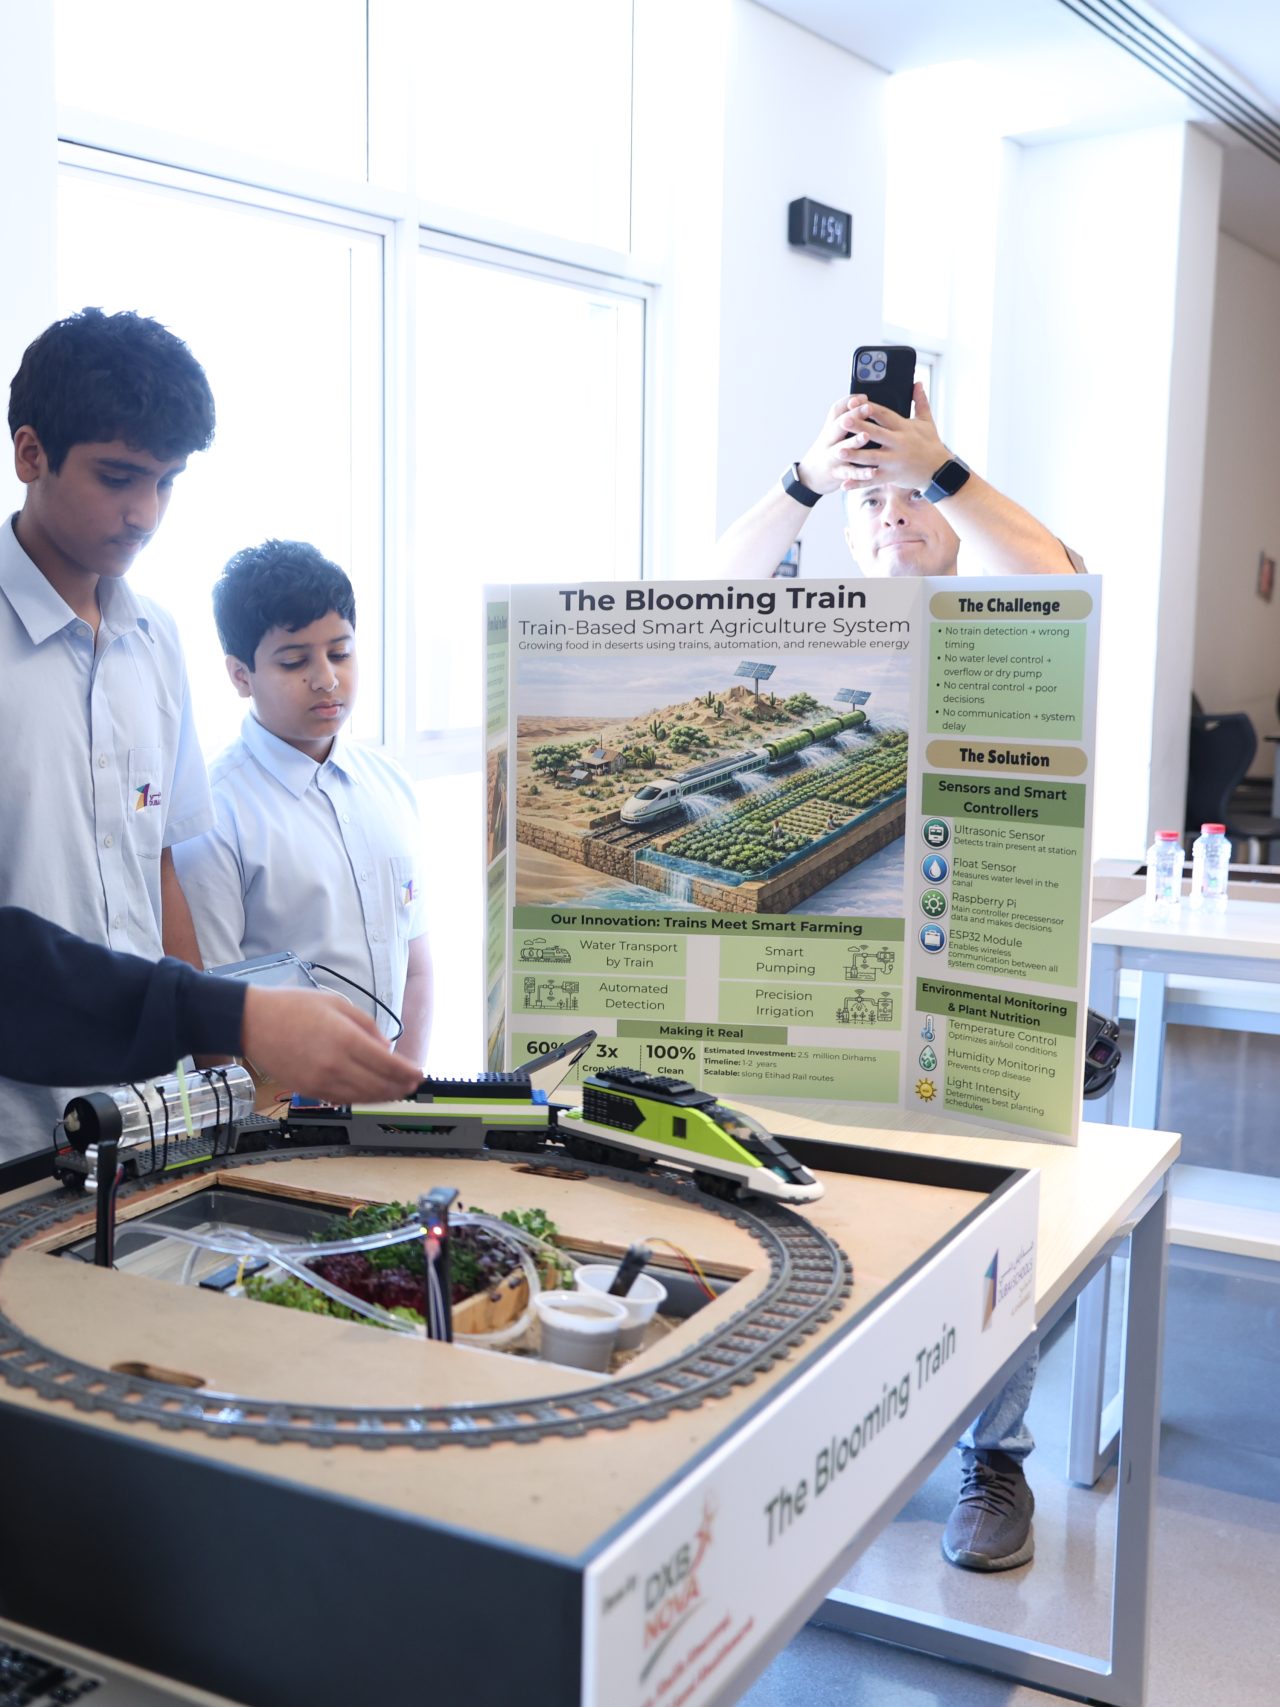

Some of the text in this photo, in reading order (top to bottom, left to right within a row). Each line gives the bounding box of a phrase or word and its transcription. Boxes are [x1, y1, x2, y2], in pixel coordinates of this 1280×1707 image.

[559, 585, 866, 615] The Blooming Train
[959, 598, 1060, 615] The Challenge
[519, 619, 635, 635] Train-Based
[643, 619, 704, 634] Smart
[710, 618, 826, 637] Agriculture
[833, 618, 910, 636] System
[946, 627, 1069, 638] No train detection wrong
[519, 639, 909, 651] Growing food in deserts using trains, automation, and renewable energy
[945, 641, 974, 650] timing
[988, 655, 1008, 663] level
[1010, 655, 1044, 663] control
[944, 668, 981, 676] overflow
[996, 669, 1010, 679] dry
[1014, 670, 1042, 678] pump
[959, 682, 989, 690] central
[992, 683, 1024, 691] control
[1035, 685, 1057, 693] poor
[943, 695, 984, 703] decisions
[943, 709, 1075, 722] No communication system
[942, 722, 966, 732] delay
[960, 748, 1049, 767] The Solution
[939, 781, 1067, 800] Sensors and Smart
[964, 802, 1038, 818] Controllers
[955, 825, 1045, 842] Ultrasonic Sensor
[954, 837, 983, 847] Detects
[986, 839, 1004, 849] train
[1006, 842, 1036, 852] present
[1048, 846, 1076, 856] station
[954, 858, 1016, 873] Float Sensor
[953, 871, 988, 881] Measures
[991, 875, 1013, 883] water
[1015, 876, 1033, 885] level
[1045, 880, 1059, 888] the
[953, 892, 1016, 908] Raspberry Pi
[952, 905, 970, 913] Main
[972, 907, 1009, 918] controller
[551, 914, 862, 936] Our Innovation: Trains Meet Smart Farming
[987, 919, 1012, 928] makes
[1015, 922, 1052, 933] decisions
[950, 930, 1022, 947] ESP32 Module
[580, 940, 677, 954] Water Transport
[765, 946, 804, 957] Smart
[949, 942, 1011, 956] Enables wireless
[606, 956, 654, 968] by Train
[948, 951, 1009, 965] communication
[1012, 959, 1046, 971] between
[948, 960, 1026, 976] system components
[757, 962, 816, 976] Pumping
[599, 983, 668, 994] Automated
[756, 989, 812, 1001] Precision
[605, 998, 665, 1010] Detection
[922, 983, 1067, 1016] Environmental Monitoring
[757, 1006, 814, 1018] Irrigation
[948, 1003, 1040, 1026] & Plant Nutrition
[660, 1026, 743, 1038] Making it Real
[950, 1019, 1057, 1046] Temperature Control
[596, 1044, 618, 1058] 3x
[949, 1032, 987, 1045] Optimizes
[1015, 1044, 1057, 1057] conditions
[646, 1045, 696, 1060] 100%
[704, 1047, 745, 1055] Estimated
[747, 1049, 796, 1058] Investment:
[813, 1052, 840, 1060] million
[843, 1054, 876, 1062] Dirhams
[583, 1065, 604, 1073] Crop
[704, 1058, 740, 1066] Timeline:
[948, 1048, 1055, 1077] Humidity Monitoring
[658, 1067, 684, 1075] Clean
[704, 1069, 740, 1077] Scalable:
[765, 1072, 790, 1080] Etihad
[793, 1073, 807, 1081] Rail
[809, 1074, 834, 1082] routes
[948, 1060, 1031, 1082] Prevents crop disease
[947, 1077, 1020, 1100] Light Intensity
[945, 1097, 983, 1111] schedules
[946, 1089, 1044, 1116] Determines best planting
[765, 1323, 955, 1546] The Blooming Train
[645, 1542, 690, 1611] DXB
[644, 1576, 699, 1648] NOVA
